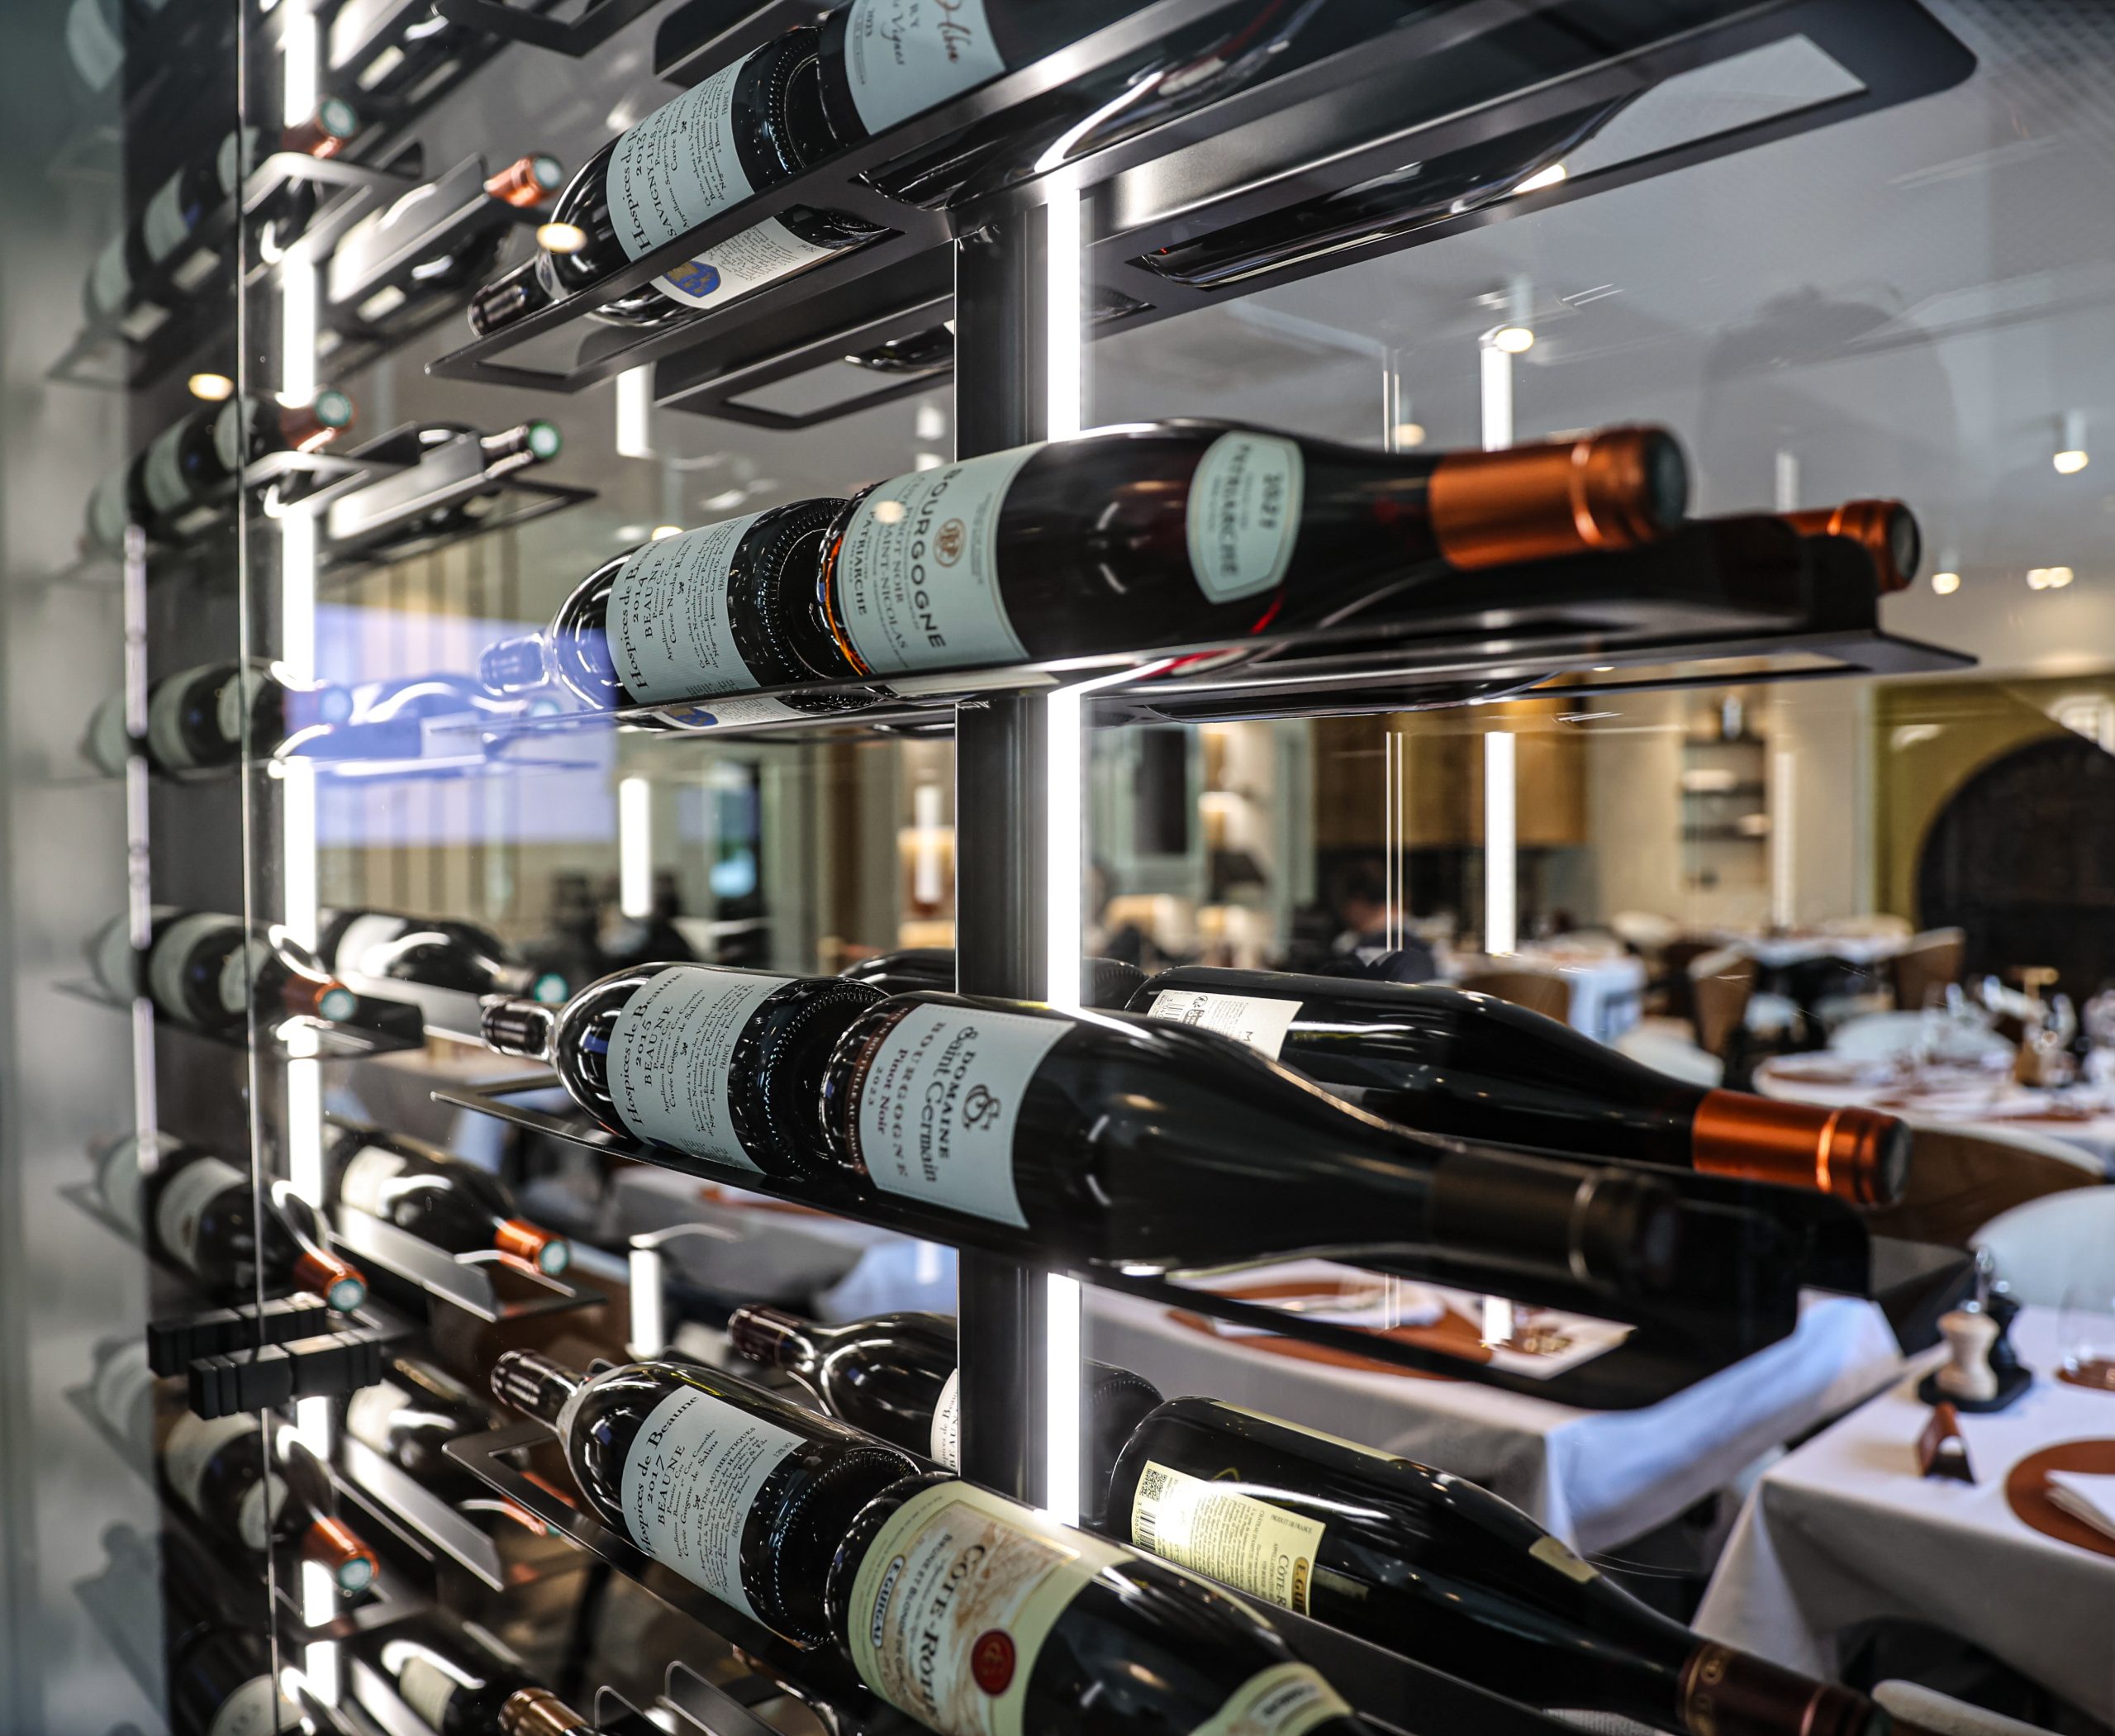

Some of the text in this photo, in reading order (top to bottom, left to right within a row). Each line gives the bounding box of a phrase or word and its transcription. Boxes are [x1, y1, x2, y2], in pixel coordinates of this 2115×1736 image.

[620, 145, 633, 164] de
[635, 133, 647, 177] 2013
[622, 167, 653, 251] Hospices
[668, 188, 690, 228] Appellation
[655, 569, 664, 585] Cru
[717, 564, 728, 592] FRANCE
[853, 511, 876, 616] PATRIARCHE
[893, 559, 905, 603] NOIR
[911, 468, 963, 649] BOURGOGNE
[619, 585, 631, 605] de
[633, 577, 648, 623] 2014
[644, 557, 664, 639] BEAUNE
[666, 544, 692, 644] Cuvée Nicolas Rolin
[620, 609, 649, 689] Hospices
[661, 619, 673, 661] Appellation
[620, 973, 682, 1125] Hospices de Beaune
[636, 1018, 653, 1067] 2015
[644, 1005, 673, 1087] BEAUNE
[654, 1020, 672, 1070] Premier Cru
[670, 1016, 681, 1030] Cru
[660, 1043, 668, 1069] Beaune
[667, 996, 706, 1108] Cuvée Guigone de Salins
[720, 1043, 731, 1069] FRANCE
[850, 1036, 881, 1100] BOUTEILLE
[933, 1025, 979, 1077] Saint
[660, 1073, 671, 1114] Appellation
[867, 1066, 883, 1107] 2023
[877, 1048, 910, 1135] Pinot Noir
[891, 1021, 947, 1178] BOURGOGNE
[939, 1050, 977, 1159] DOMAINE
[634, 1396, 699, 1555] Hospices de Beaune
[647, 1453, 664, 1505] 2017
[658, 1444, 686, 1527] BEAUNE
[666, 1463, 685, 1515] Premier Cru
[700, 1486, 711, 1510] VINS
[708, 1426, 756, 1486] AUTHENTIQUES
[673, 1429, 716, 1561] Appellation Beaune Cru Contrôlée
[680, 1439, 719, 1558] Cuvée Guigone de Salins
[730, 1510, 743, 1539] FRANCE
[921, 1532, 953, 1569] BRUNE
[913, 1569, 926, 1586] ET
[872, 1575, 896, 1643] GUIGAL
[896, 1585, 919, 1637] BLONDE
